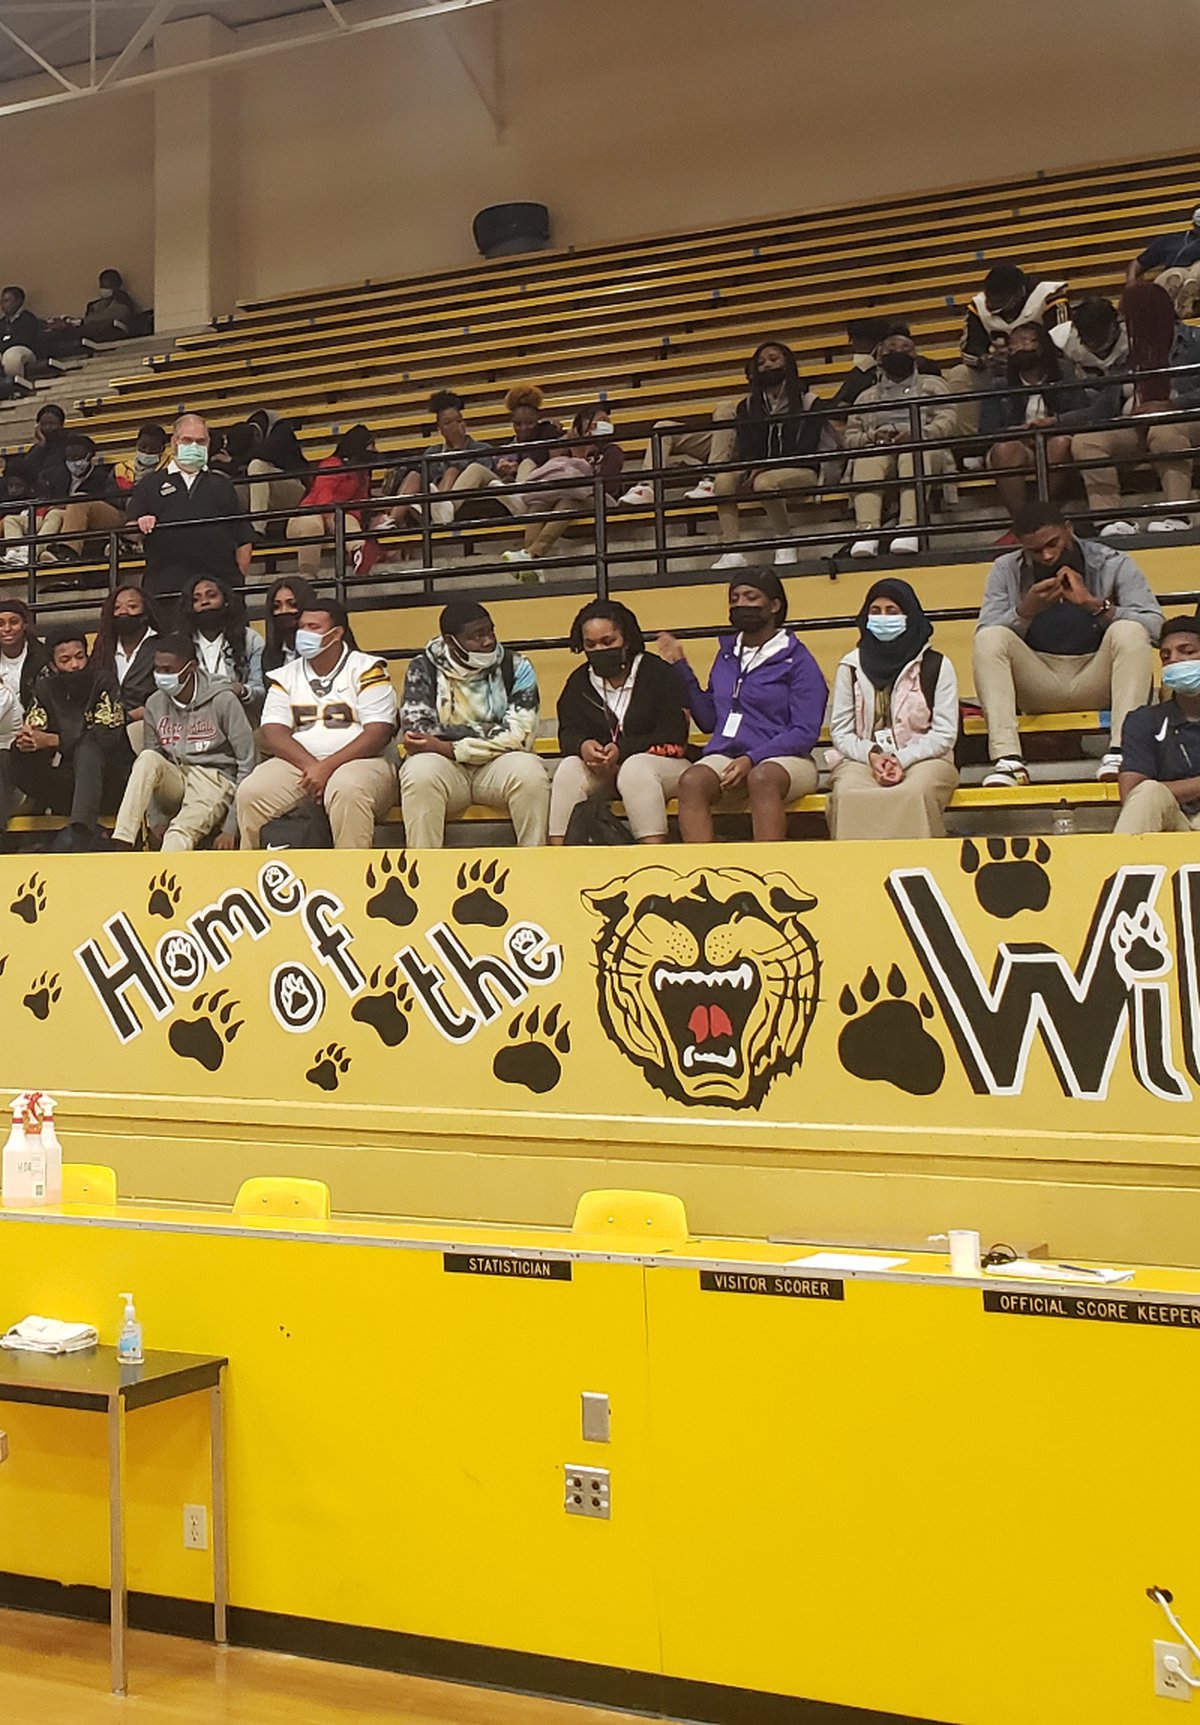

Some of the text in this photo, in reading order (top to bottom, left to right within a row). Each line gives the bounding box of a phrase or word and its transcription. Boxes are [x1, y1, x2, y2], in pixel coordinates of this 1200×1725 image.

[74, 860, 306, 1044] Home
[268, 889, 366, 1033] of
[394, 921, 565, 1045] the
[468, 1257, 551, 1276] STATISTICIAN
[714, 1273, 830, 1296] VISITOR SCORER
[999, 1294, 1200, 1324] OFFICIAL SCORE KEEPER
